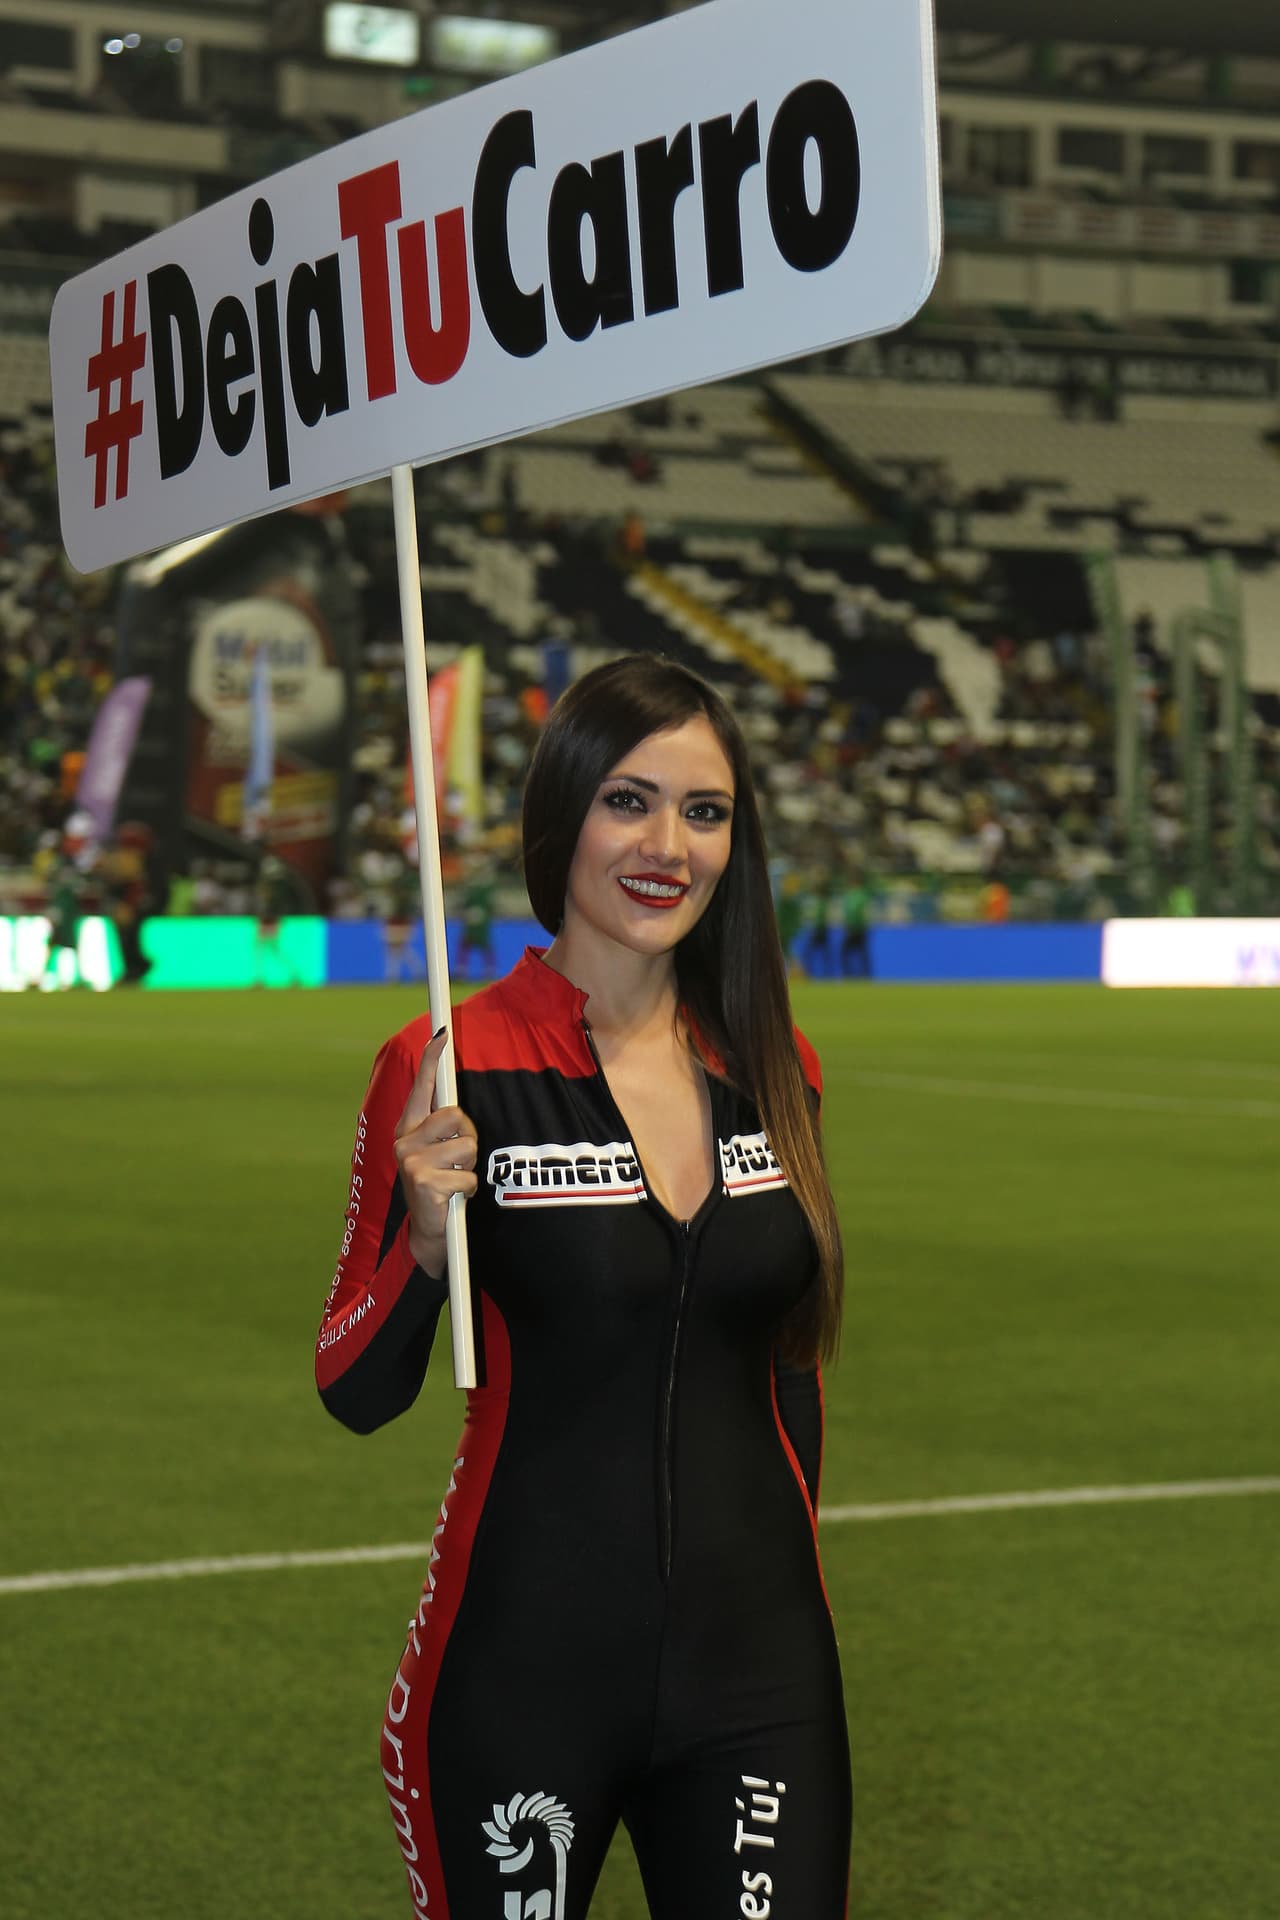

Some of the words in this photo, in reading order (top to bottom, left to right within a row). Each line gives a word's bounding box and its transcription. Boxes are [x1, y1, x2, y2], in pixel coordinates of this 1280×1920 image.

[84, 78, 861, 509] #DejaTuCarro
[350, 1173, 363, 1216] 375
[733, 1774, 786, 1855] Tú!
